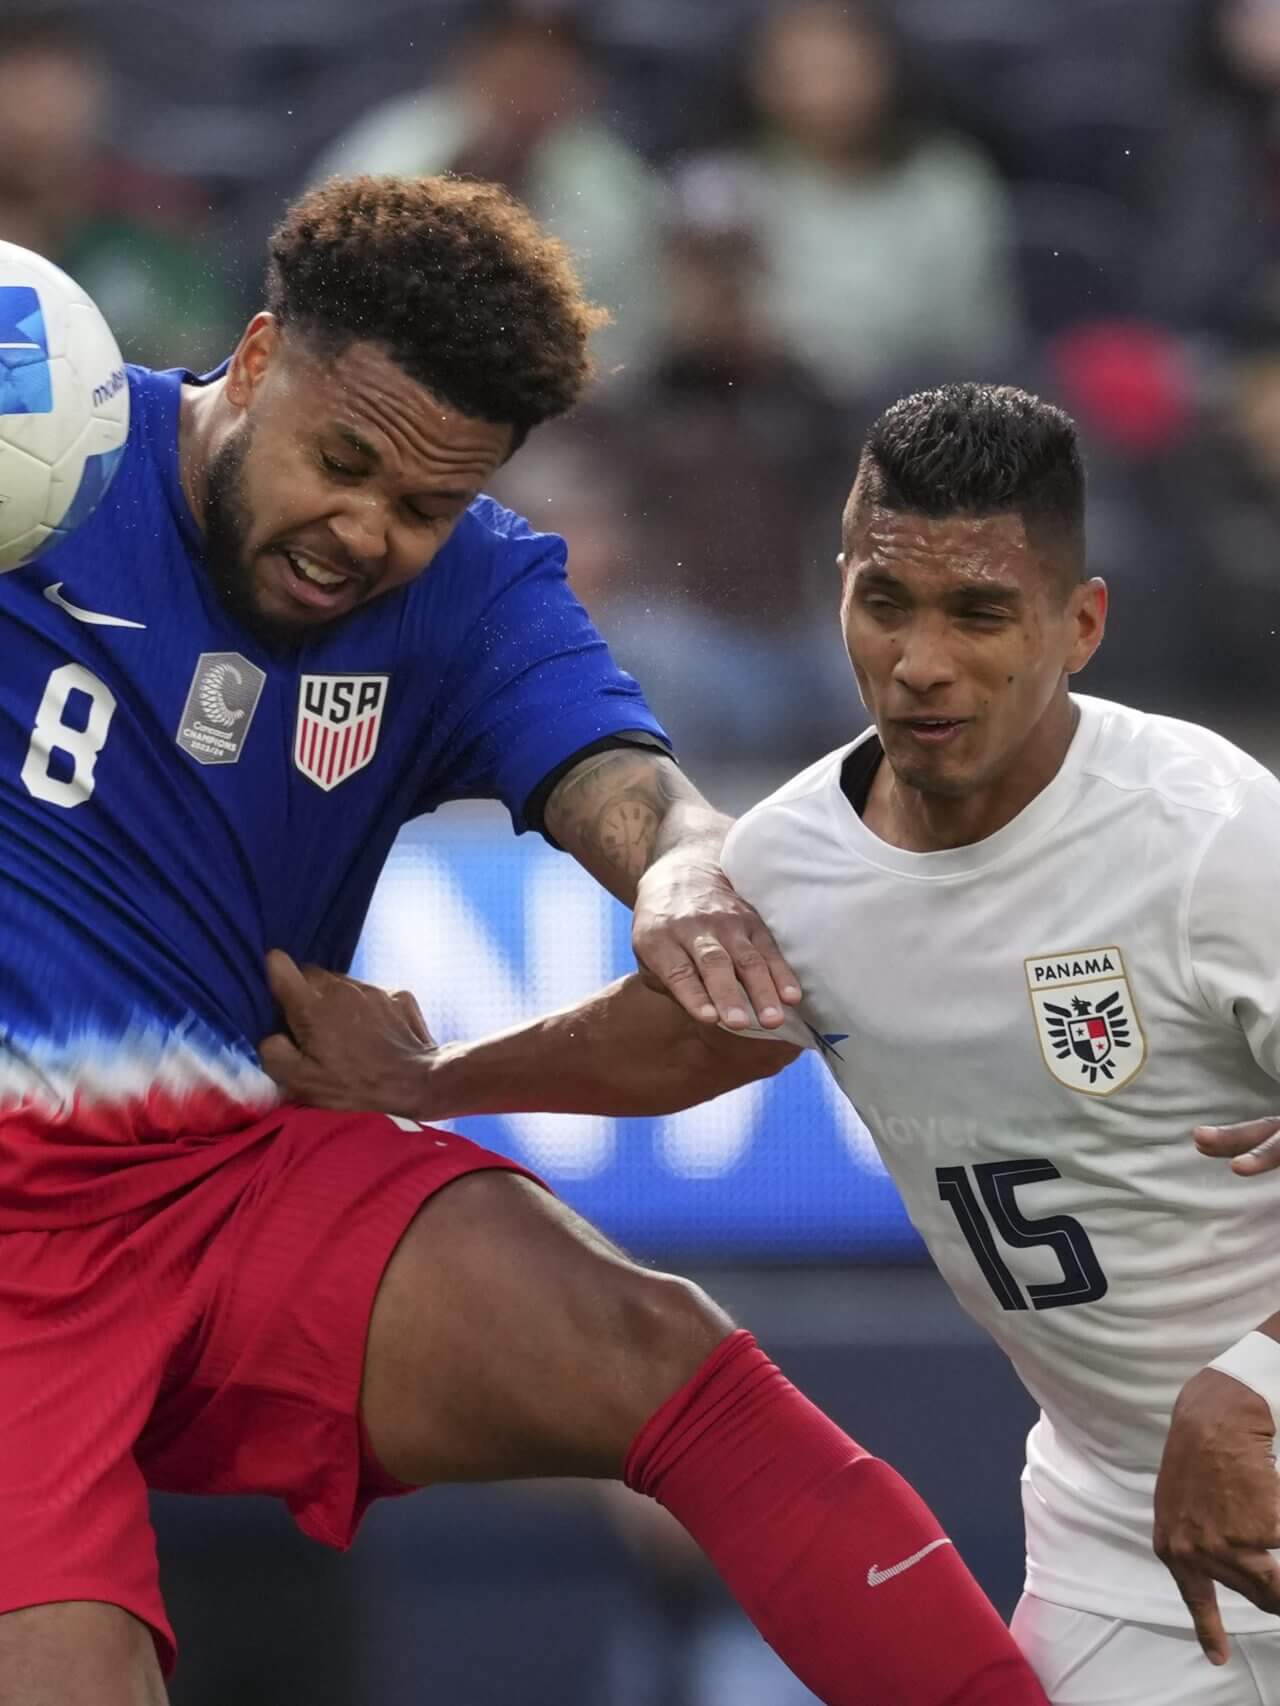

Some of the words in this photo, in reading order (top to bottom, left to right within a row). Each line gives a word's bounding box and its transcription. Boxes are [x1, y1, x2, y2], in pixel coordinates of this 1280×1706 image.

[304, 681, 382, 724] USA
[20, 662, 117, 809] 8
[183, 729, 237, 752] CHAMPIONS
[1034, 953, 1115, 982] PANAMÁ
[934, 1158, 1109, 1311] 15
